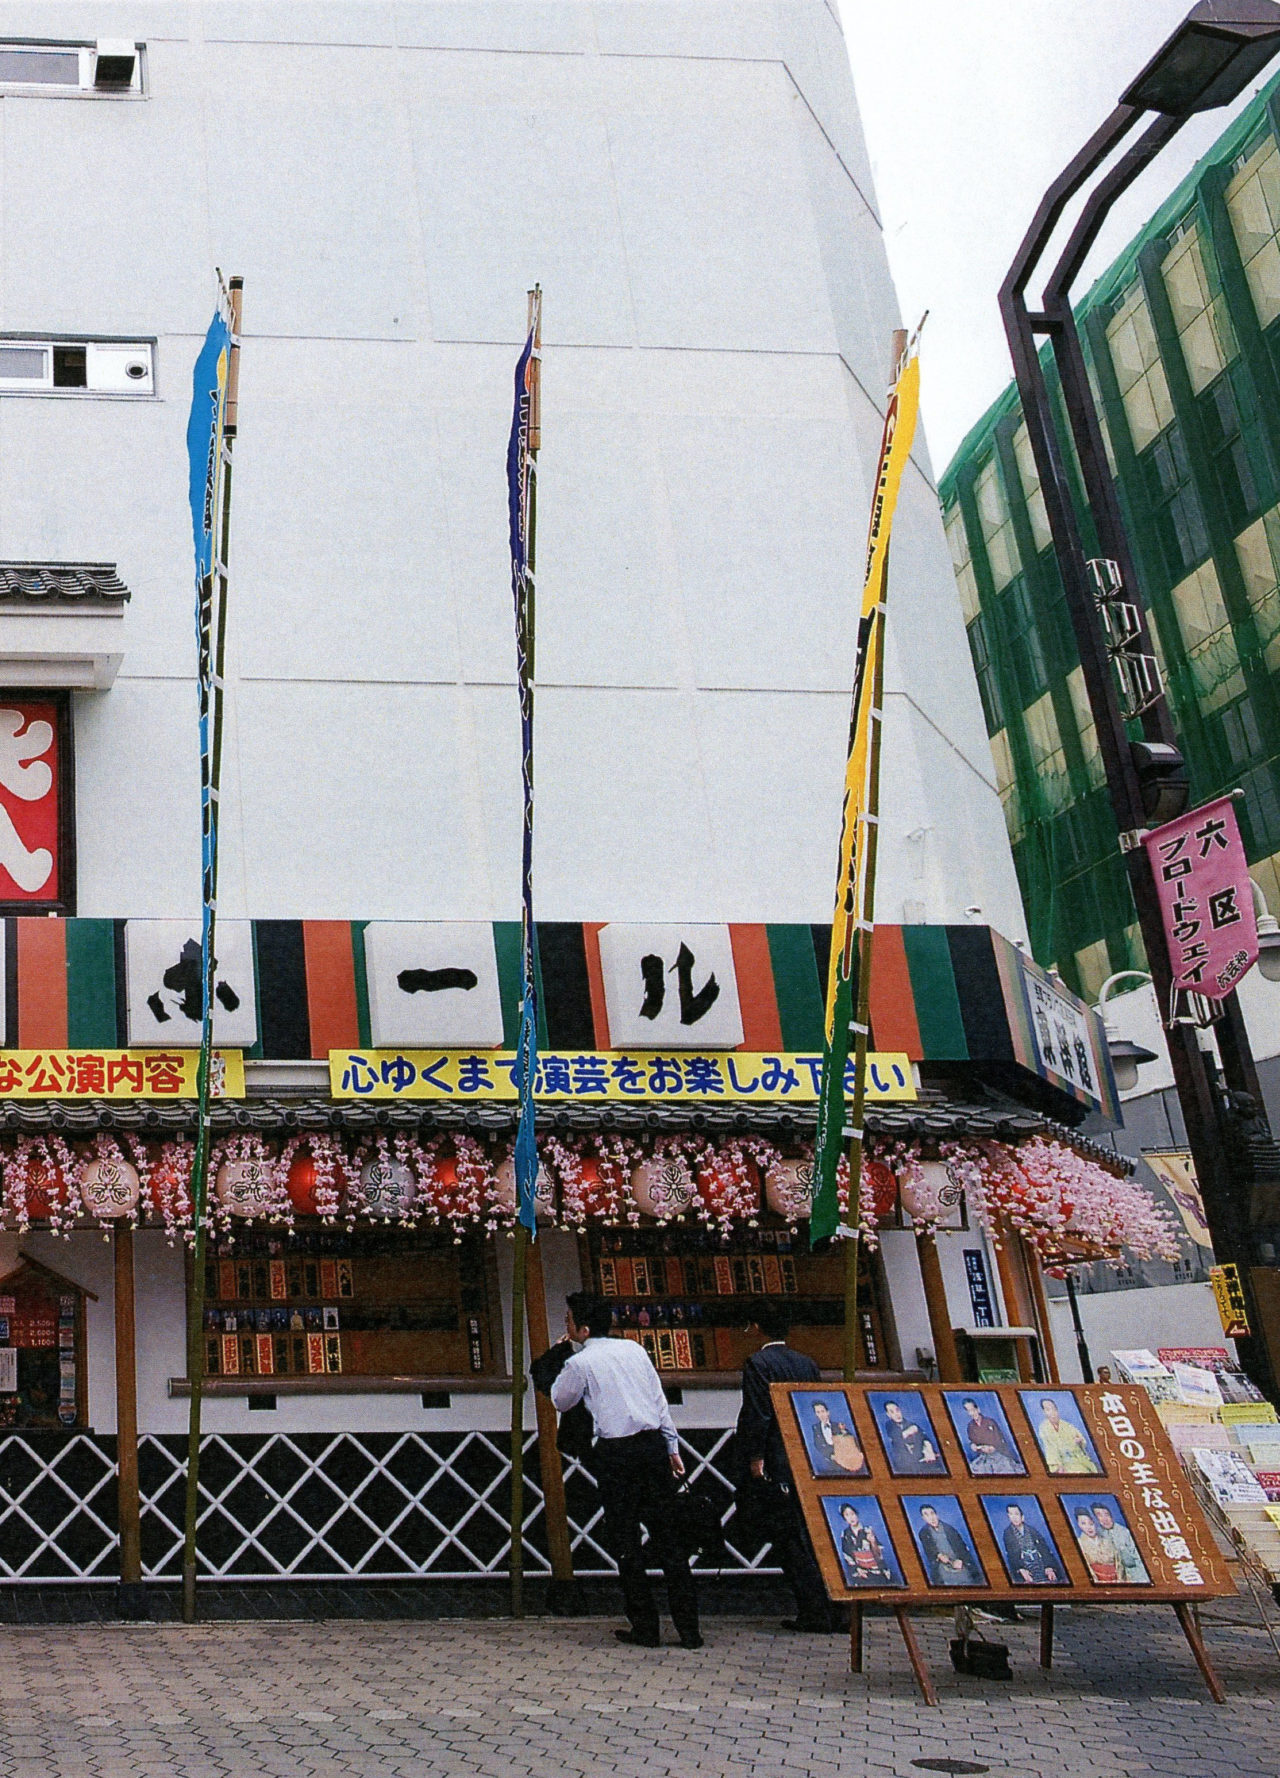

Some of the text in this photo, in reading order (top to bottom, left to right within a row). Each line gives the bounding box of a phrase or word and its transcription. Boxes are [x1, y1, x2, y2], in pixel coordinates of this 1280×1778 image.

[1195, 819, 1241, 930] 六区
[1098, 1391, 1206, 1587] 本日の主な出演者
